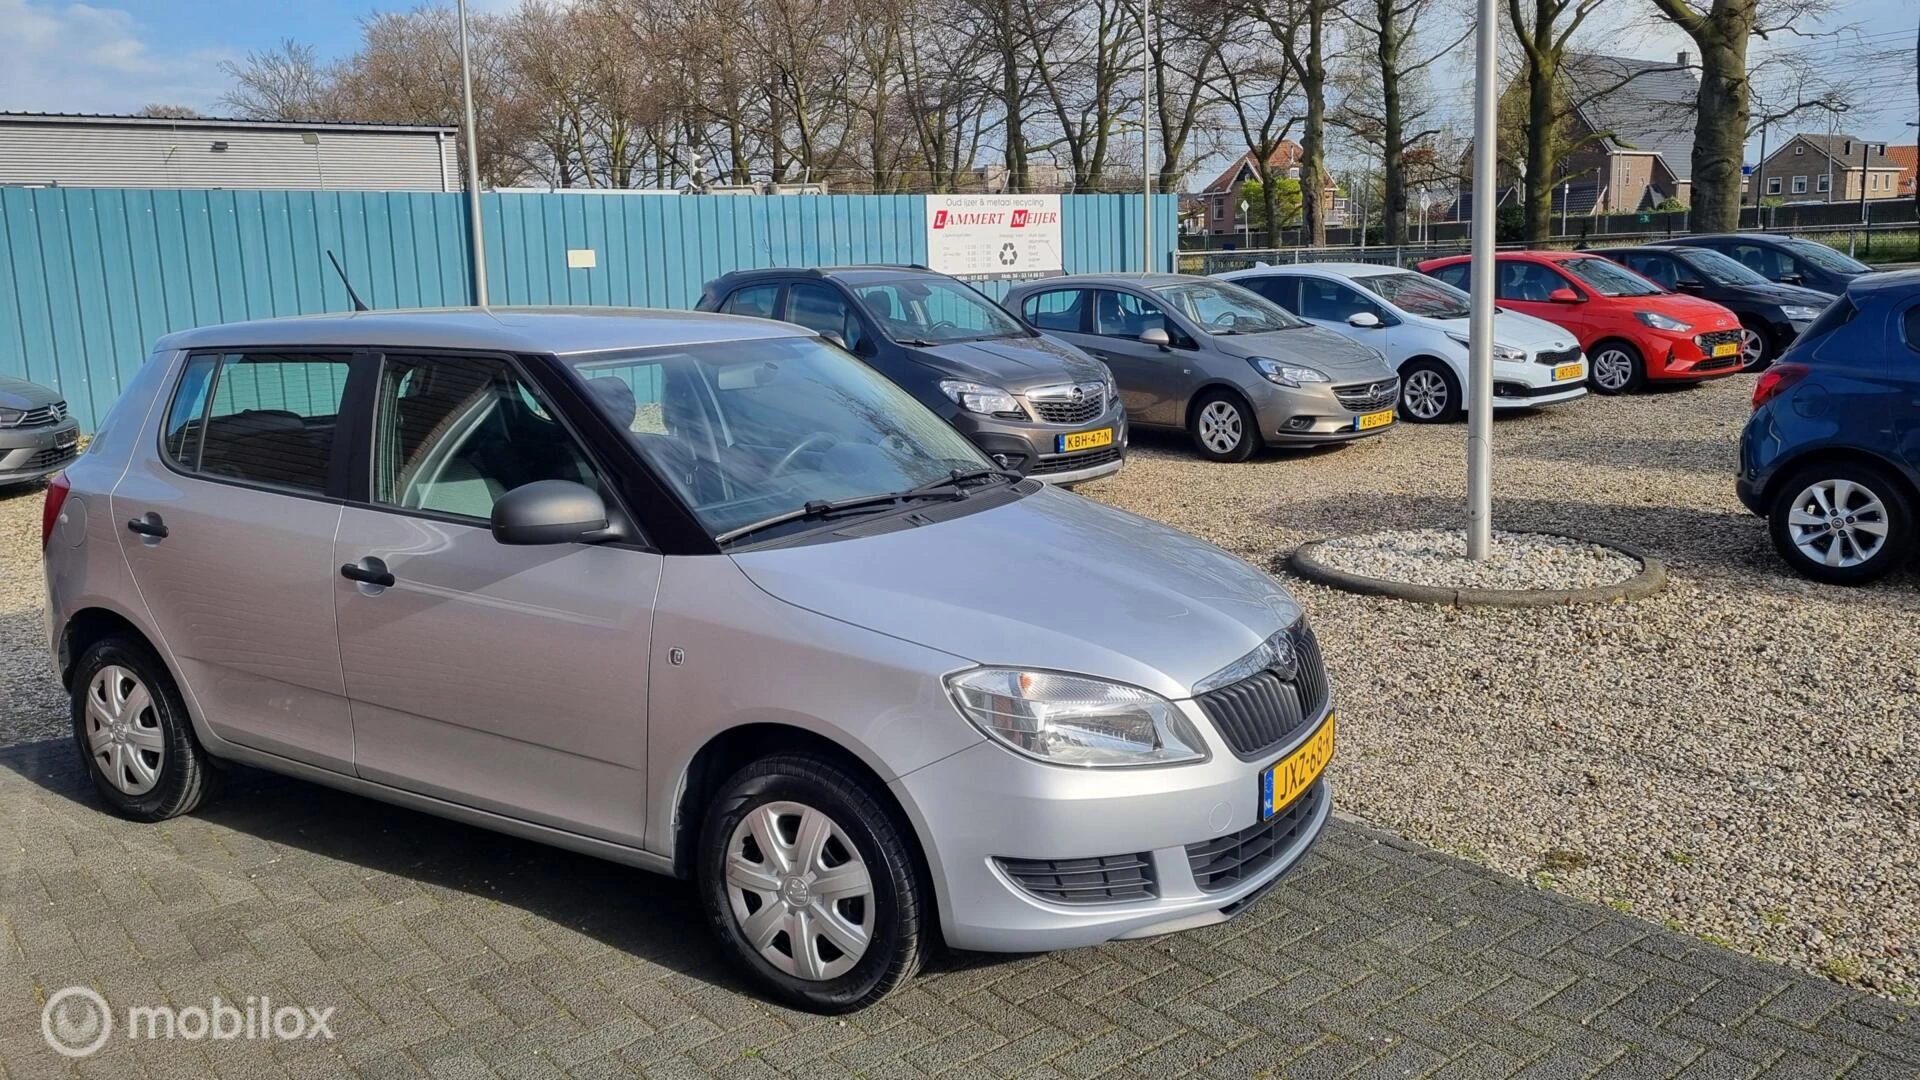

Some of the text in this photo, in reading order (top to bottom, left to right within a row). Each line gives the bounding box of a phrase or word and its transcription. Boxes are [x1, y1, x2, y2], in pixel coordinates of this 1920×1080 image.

[946, 198, 962, 207] Oud
[987, 198, 1012, 207] metaal
[1013, 198, 1044, 208] recycling
[933, 209, 1057, 229] LAMMERT MEIJER
[1362, 412, 1390, 426] KBG-91-B
[1067, 431, 1109, 448] KBH-47-N
[1280, 725, 1331, 800] JXZ-68-R
